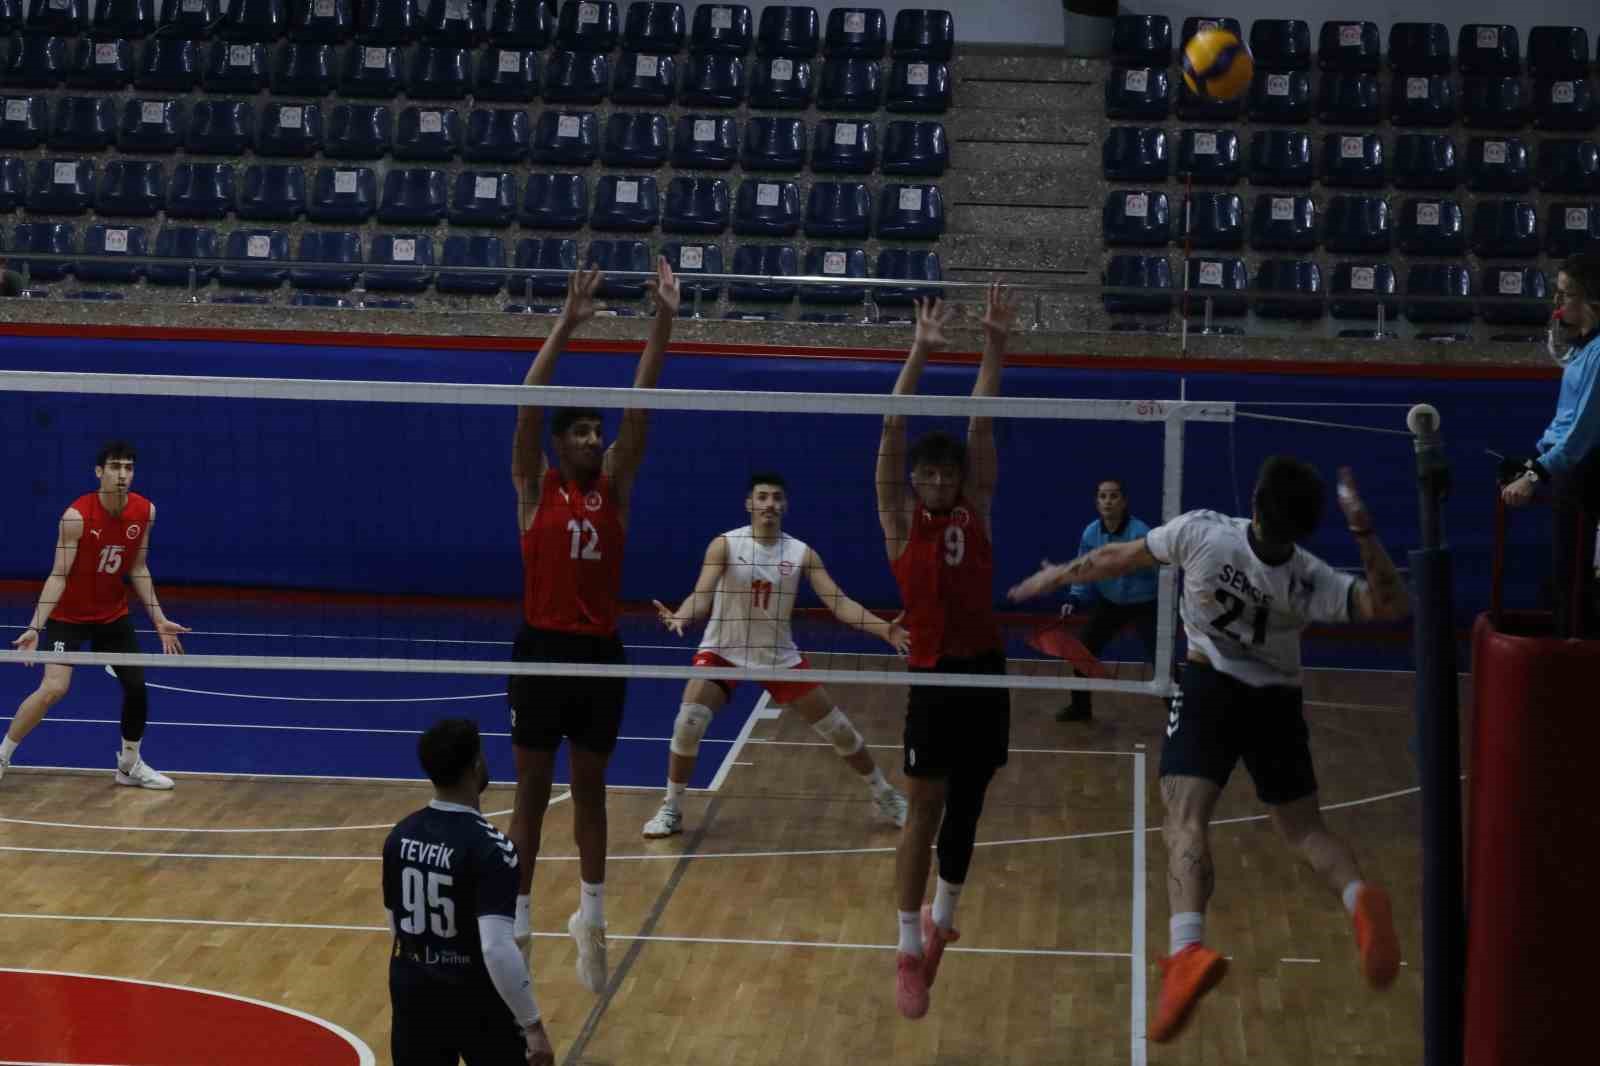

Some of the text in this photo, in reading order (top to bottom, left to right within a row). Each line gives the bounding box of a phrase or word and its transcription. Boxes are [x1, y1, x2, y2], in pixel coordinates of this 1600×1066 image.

[567, 518, 601, 560] 12
[944, 525, 966, 567] 9
[97, 545, 126, 575] 15
[752, 580, 773, 610] 11
[400, 838, 455, 869] TEVFİK
[400, 866, 459, 939] 95
